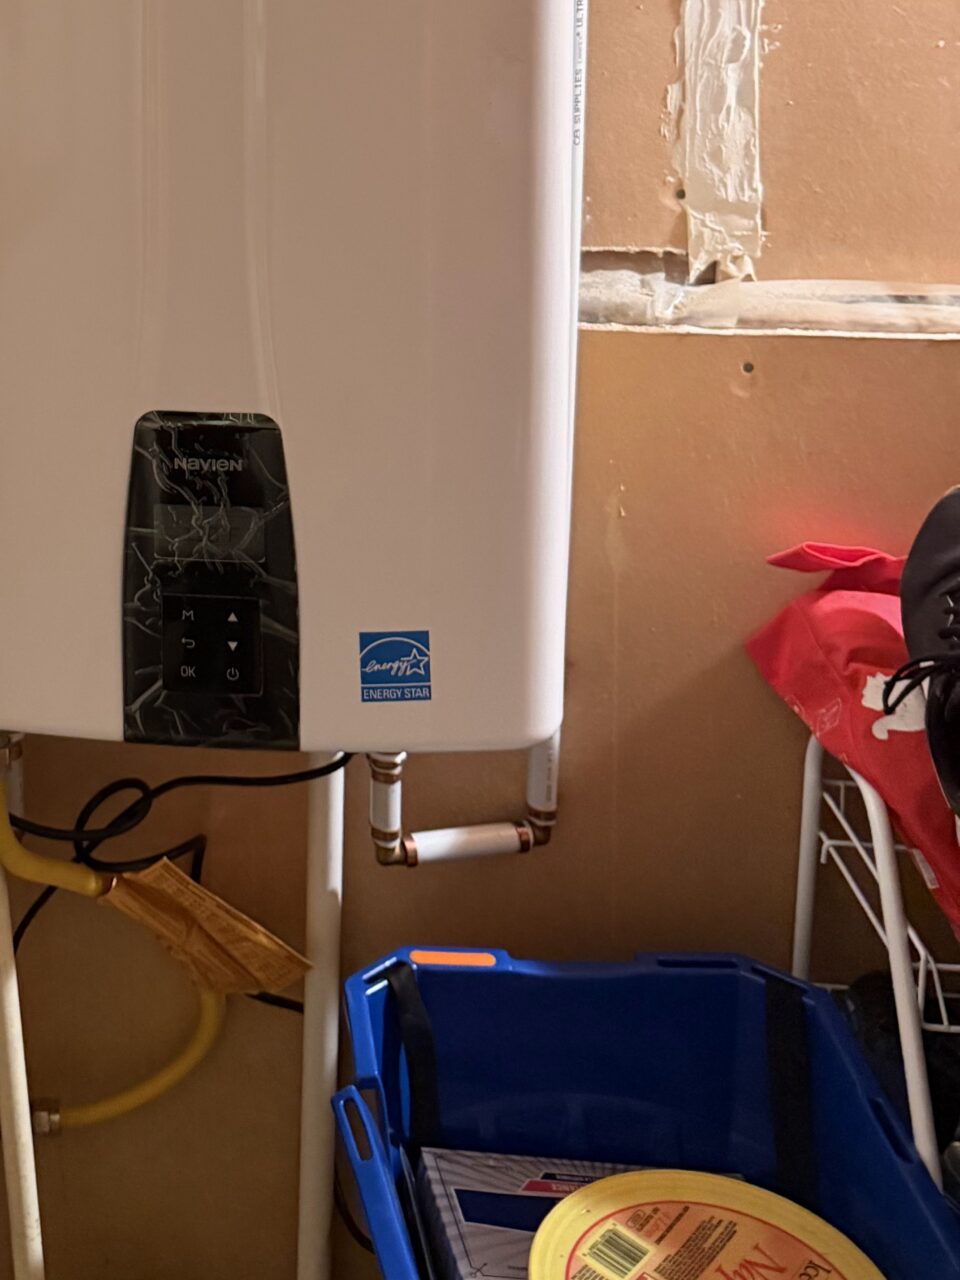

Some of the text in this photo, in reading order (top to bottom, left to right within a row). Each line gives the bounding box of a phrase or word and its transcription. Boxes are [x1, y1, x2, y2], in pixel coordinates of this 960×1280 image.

[180, 665, 196, 678] OK
[363, 686, 430, 700] ENERGY STAR
